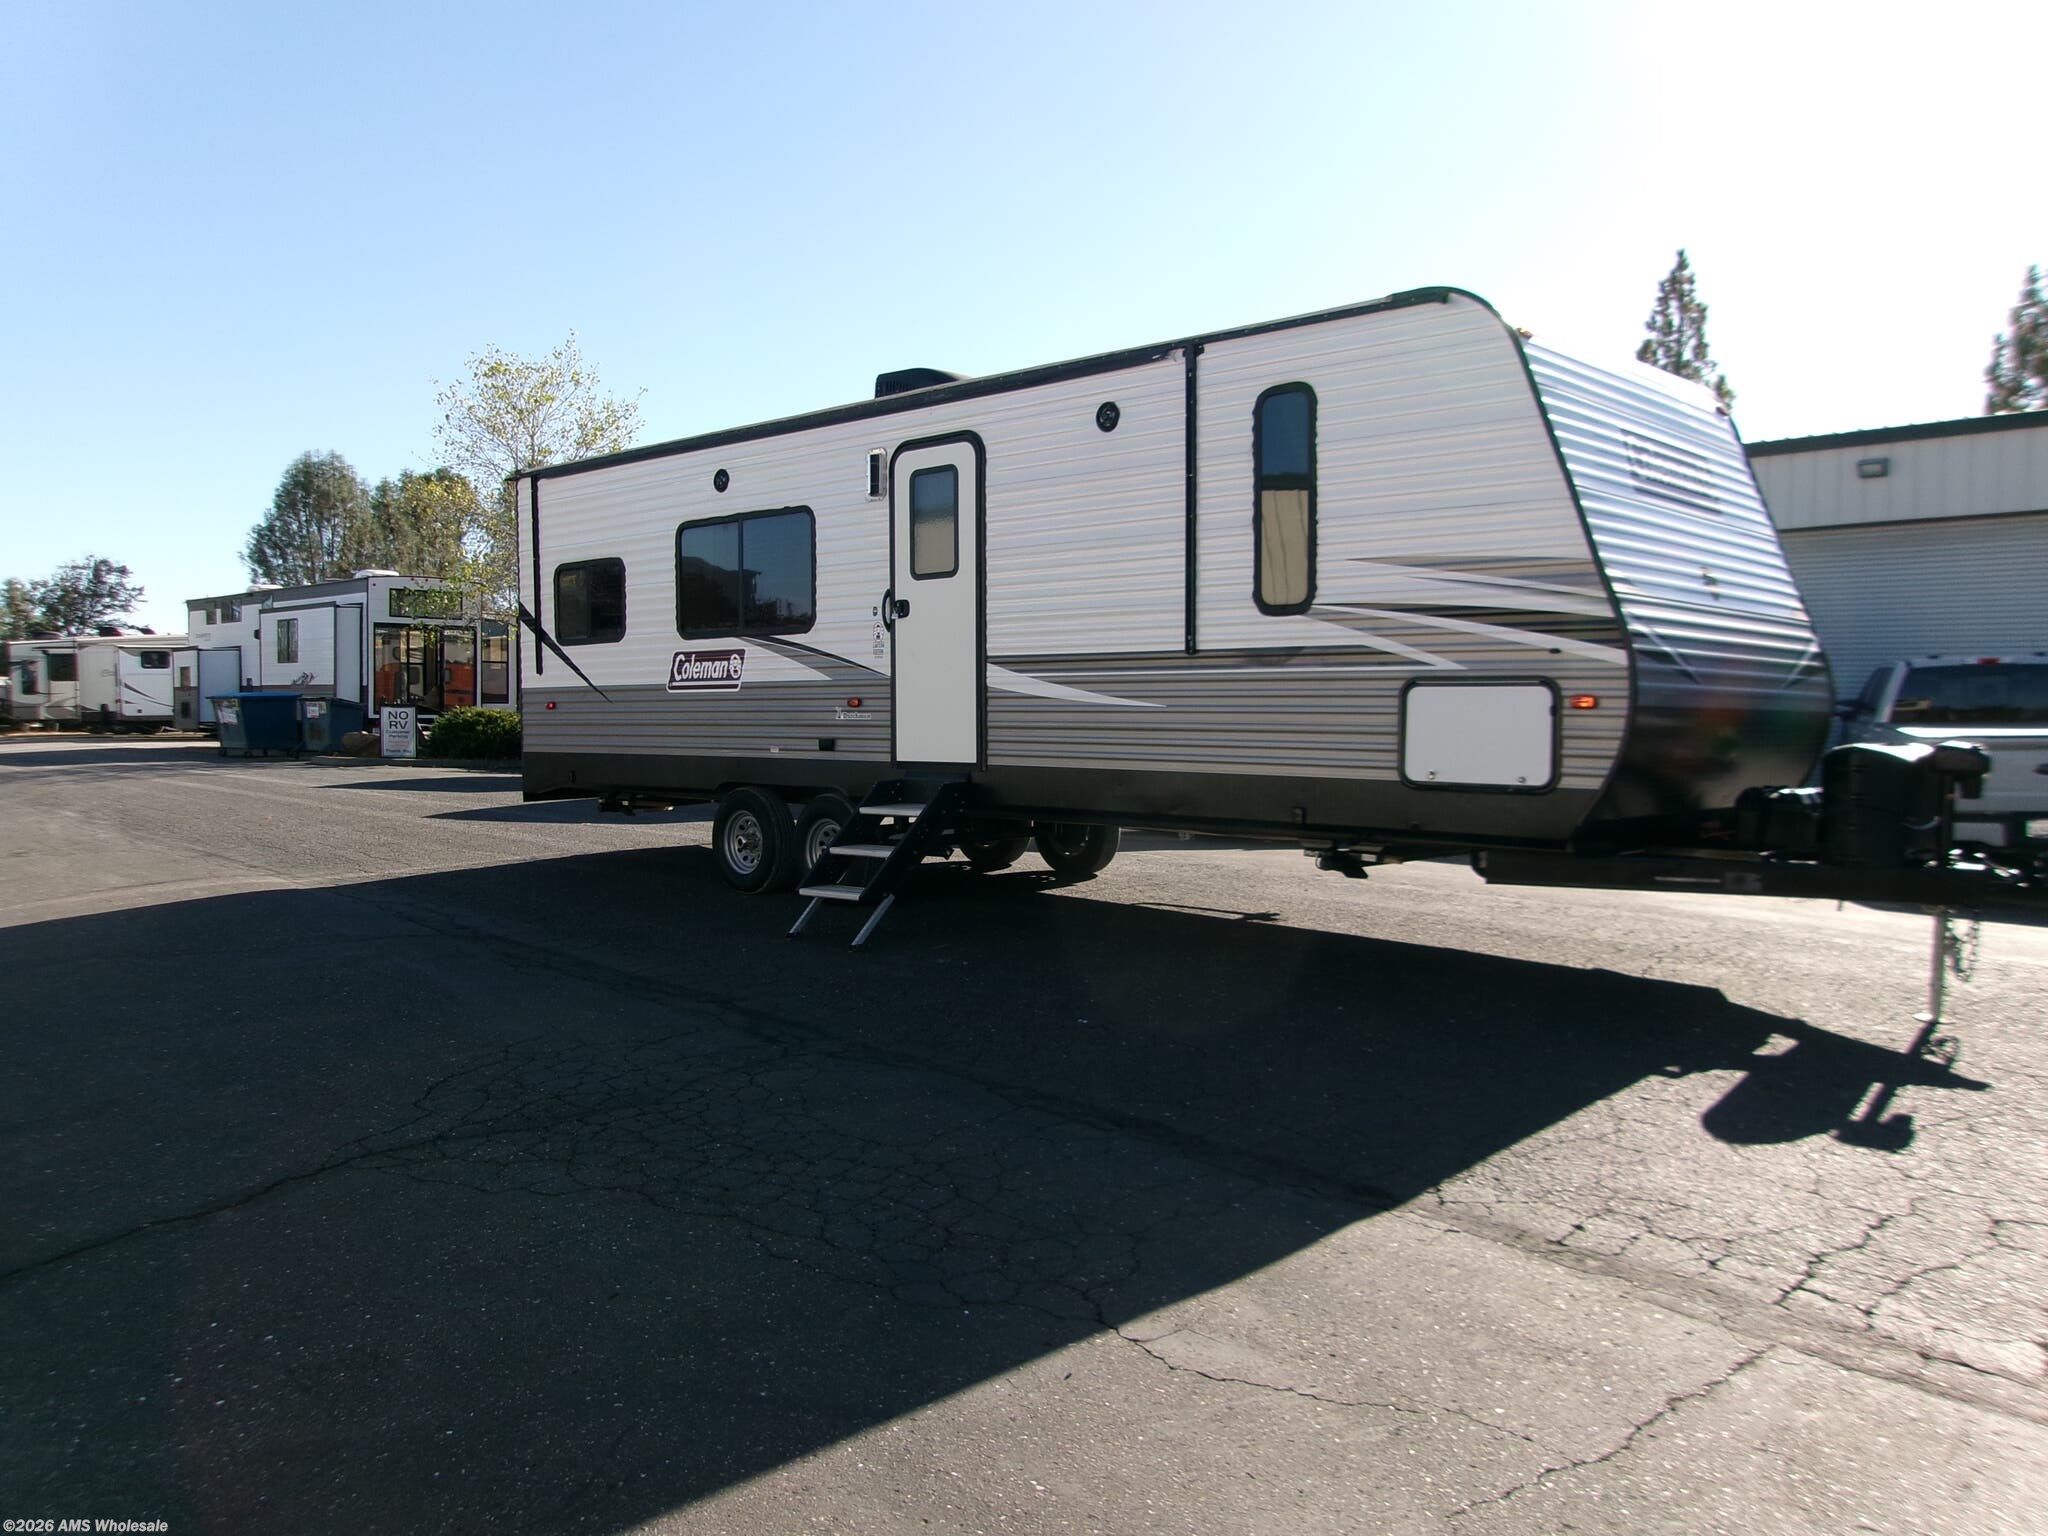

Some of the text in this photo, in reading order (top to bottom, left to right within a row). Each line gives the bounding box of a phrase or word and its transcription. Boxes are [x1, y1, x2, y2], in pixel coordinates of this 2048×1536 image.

[673, 654, 728, 681] Coleman
[388, 711, 409, 720] NO
[389, 721, 408, 730] RV
